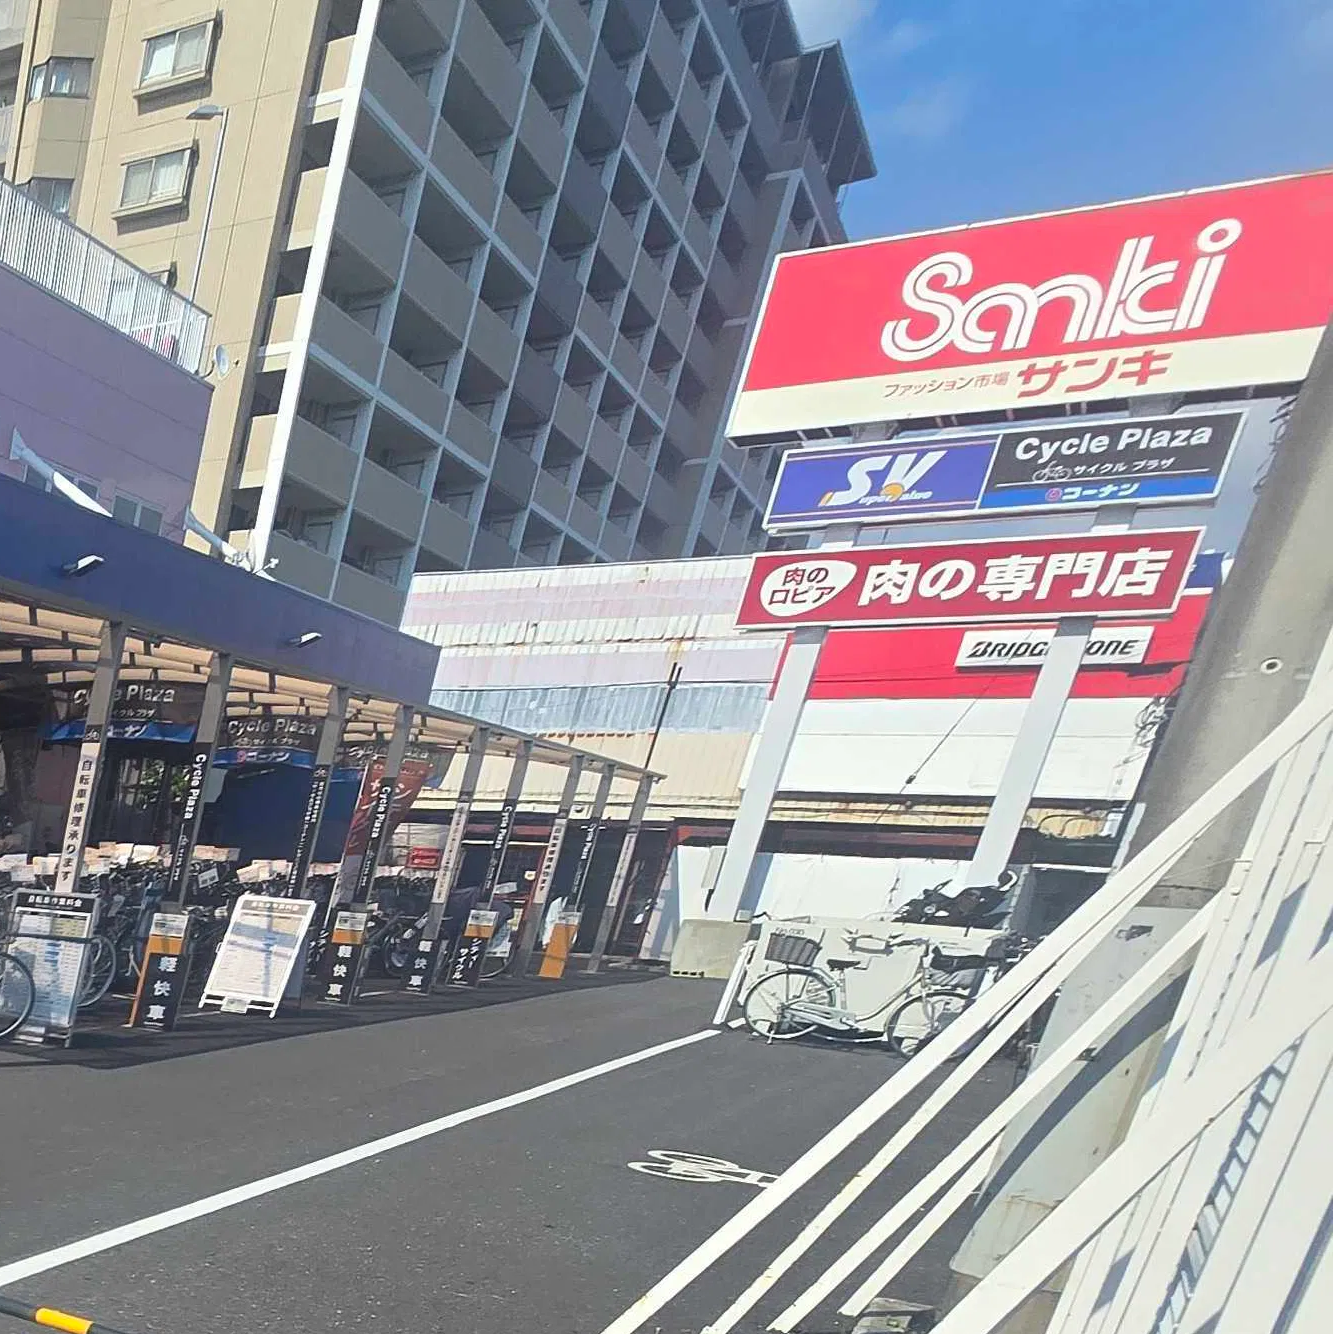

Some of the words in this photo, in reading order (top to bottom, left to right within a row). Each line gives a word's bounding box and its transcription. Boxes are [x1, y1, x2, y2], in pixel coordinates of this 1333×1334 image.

[881, 218, 1243, 362] Sanki
[885, 371, 1009, 399] ファッション市場
[1017, 348, 1173, 399] サンキ
[1015, 430, 1109, 464] Cycle
[1118, 423, 1213, 452] Plaza
[1073, 461, 1124, 475] サイクル
[1133, 457, 1175, 471] プラザ
[1061, 482, 1141, 500] コーナン
[783, 566, 828, 585] 肉の
[858, 547, 1172, 606] 肉の専門店
[768, 584, 836, 606] ロピア
[966, 638, 1136, 660] BRIDGONE
[126, 684, 176, 703] Plaza
[228, 719, 270, 736] Cycle
[274, 718, 317, 736] Plaza
[190, 753, 207, 787] Cycle
[246, 751, 290, 762] コーナン
[183, 788, 203, 820] Plaza
[377, 786, 391, 812] Cycle
[61, 759, 95, 882] 自転車修理承ります
[371, 813, 386, 838] Plaza
[467, 938, 483, 969] シティー
[327, 945, 353, 996] 軽快車
[147, 956, 179, 1021] 軽快車
